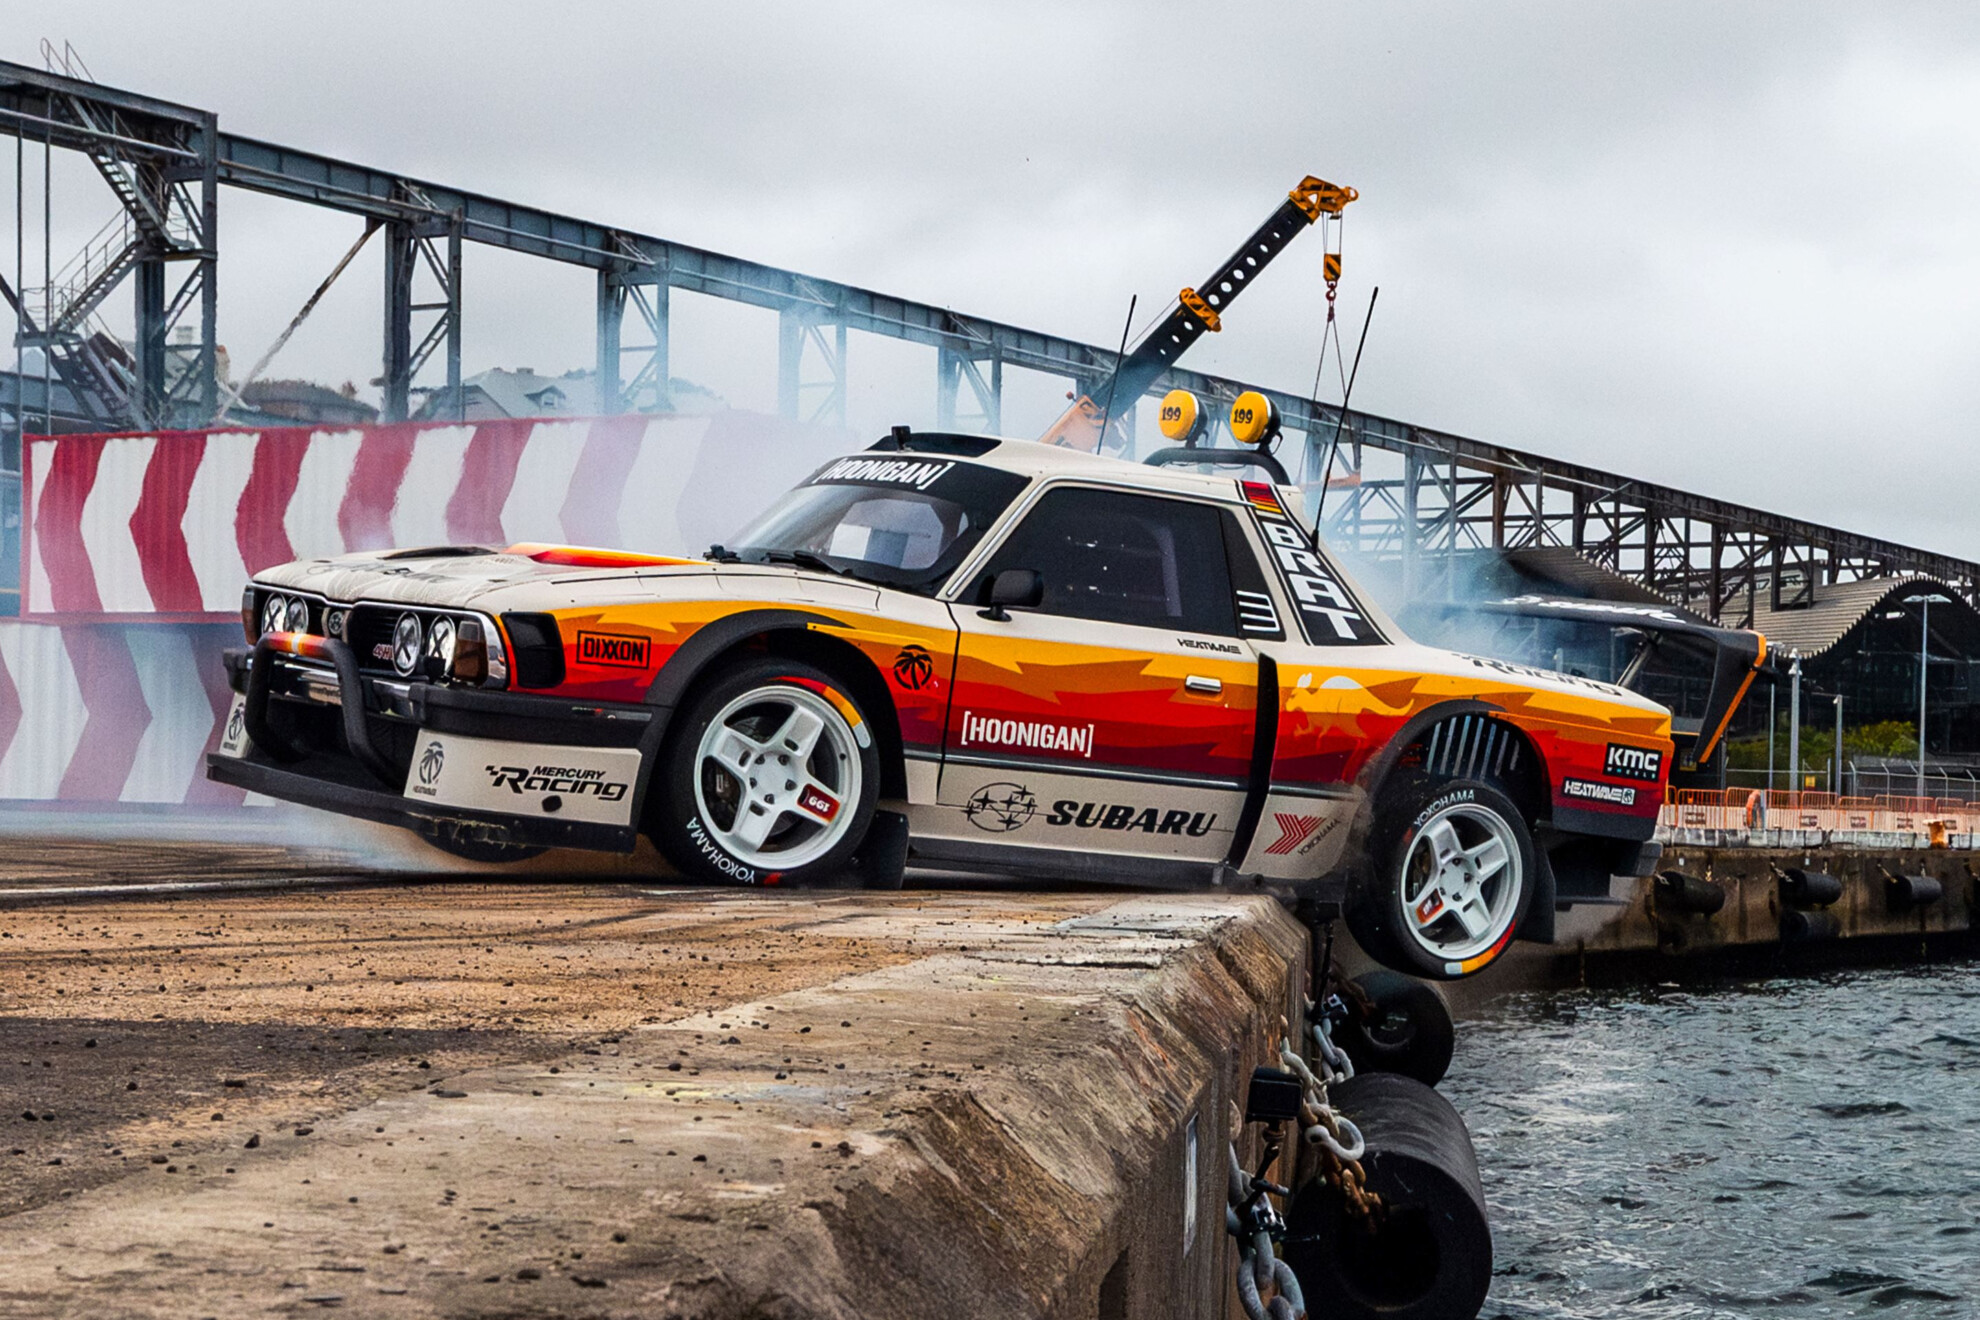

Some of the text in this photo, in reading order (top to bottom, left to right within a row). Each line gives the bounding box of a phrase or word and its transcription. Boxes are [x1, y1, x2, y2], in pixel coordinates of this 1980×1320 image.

[1162, 406, 1182, 421] 199
[1233, 408, 1253, 424] 199
[1262, 520, 1361, 640] BRAT
[583, 636, 644, 663] DIXXON
[1176, 638, 1242, 655] HEATWAVE
[1607, 746, 1659, 772] KMC
[532, 765, 606, 780] MERCURY
[807, 794, 832, 813] 199
[1564, 780, 1623, 802] HEATWAVE
[1046, 799, 1218, 837] SUBARU
[1414, 788, 1475, 828] YOKOHAMA
[1297, 818, 1342, 856] YOKOHAMA
[686, 816, 755, 885] YOKOHAMA
